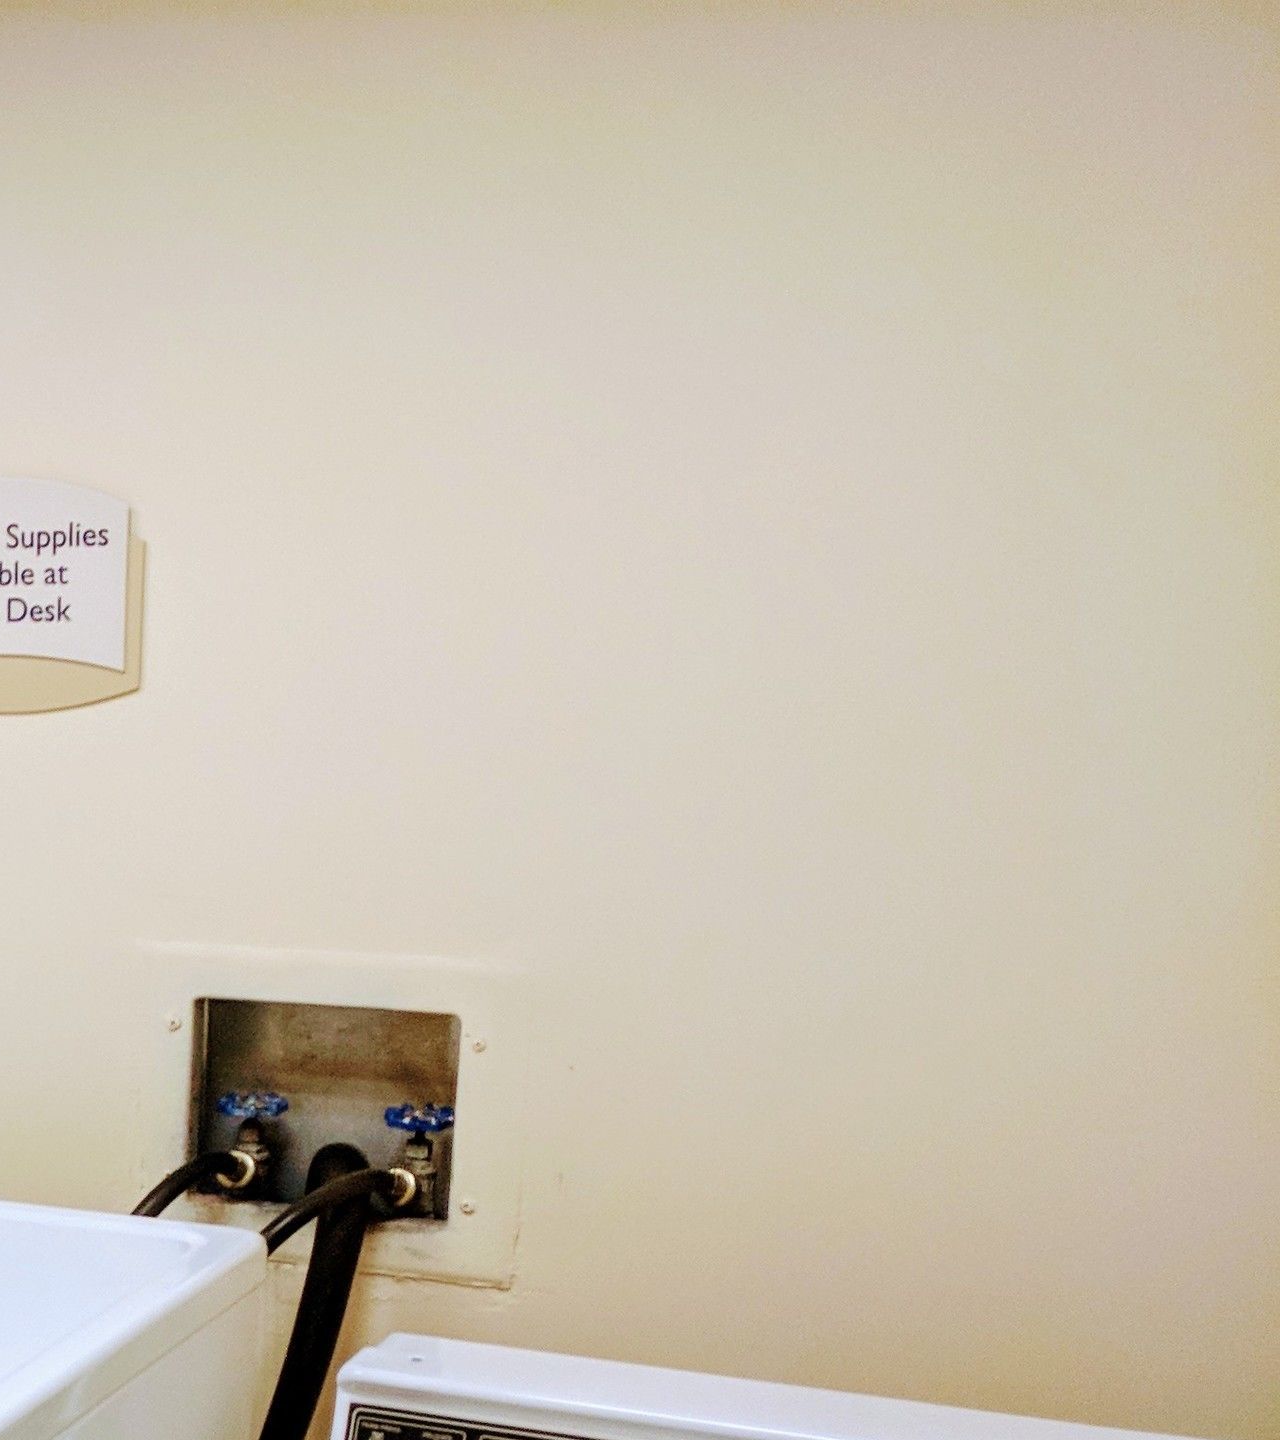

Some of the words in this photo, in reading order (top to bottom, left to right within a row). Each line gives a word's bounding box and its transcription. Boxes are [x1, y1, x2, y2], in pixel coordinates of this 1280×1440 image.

[6, 521, 110, 556] Supplies
[44, 565, 69, 585] at
[7, 596, 72, 623] Desk
